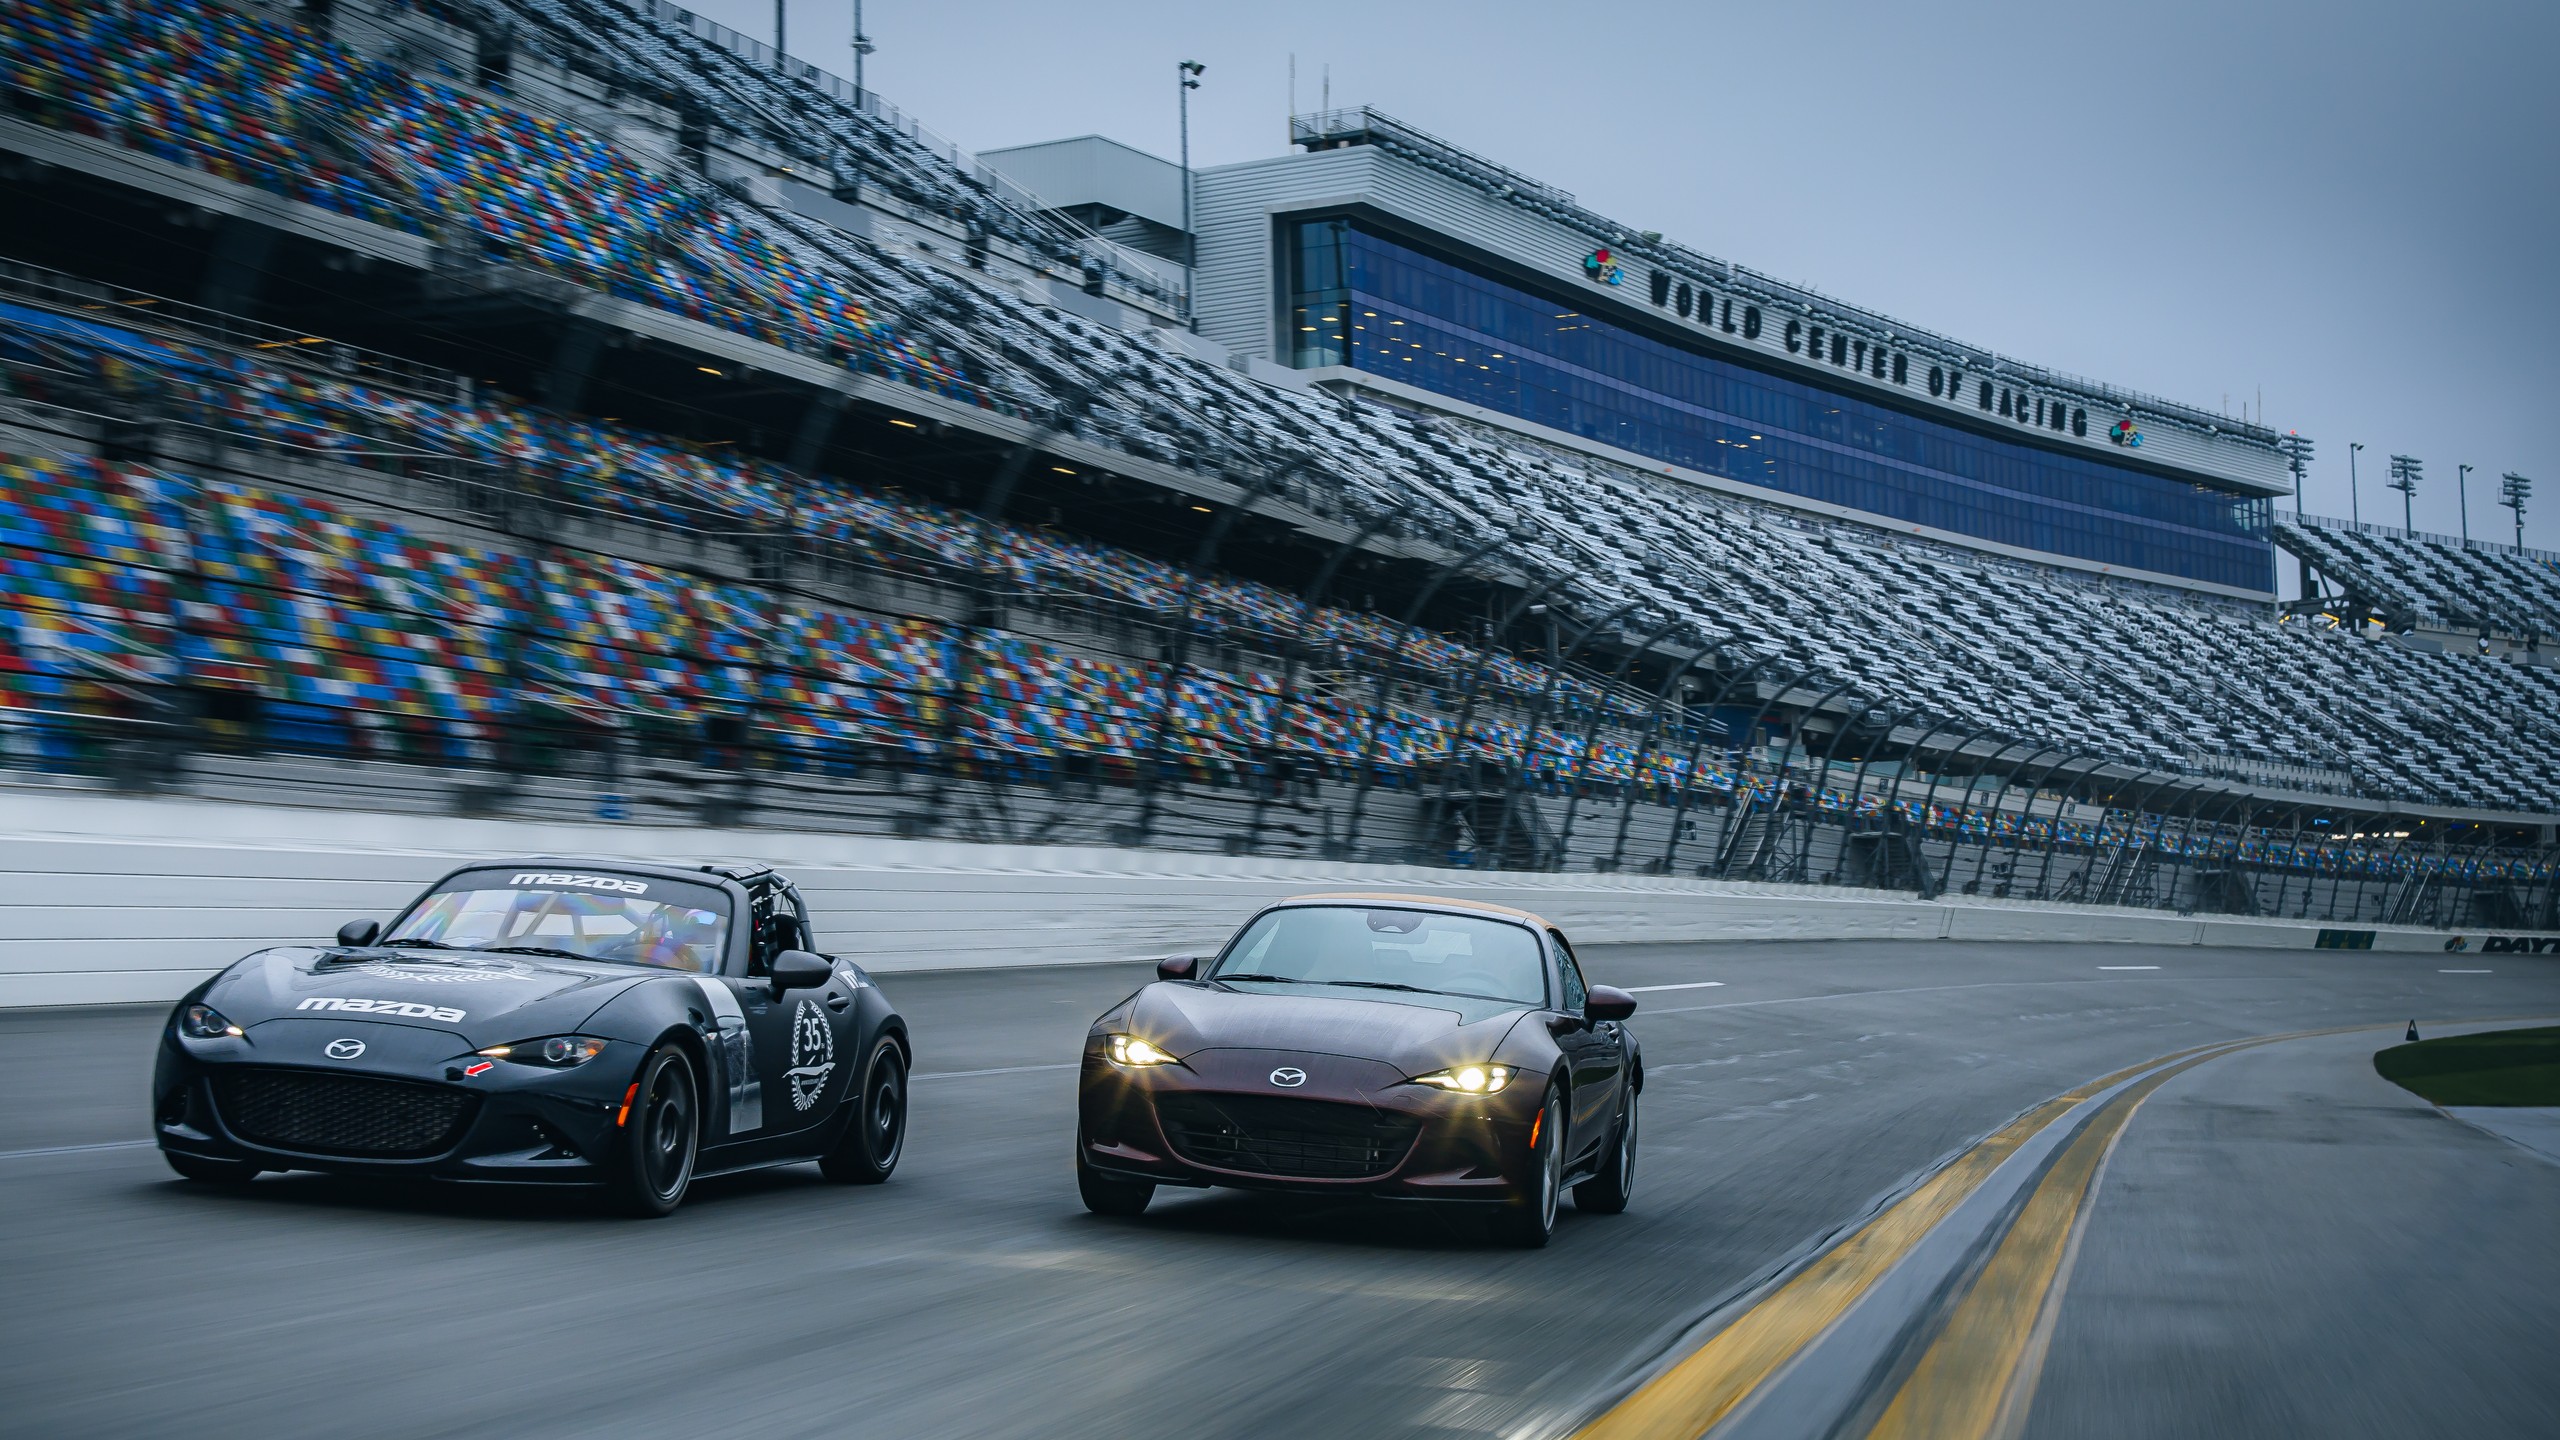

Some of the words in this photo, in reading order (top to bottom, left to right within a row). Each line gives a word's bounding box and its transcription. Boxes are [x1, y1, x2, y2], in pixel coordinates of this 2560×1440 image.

[1649, 268, 1762, 340] WORLD
[1785, 320, 1908, 385] CENTER
[1929, 366, 1963, 400] OF
[1980, 380, 2087, 437] RACING
